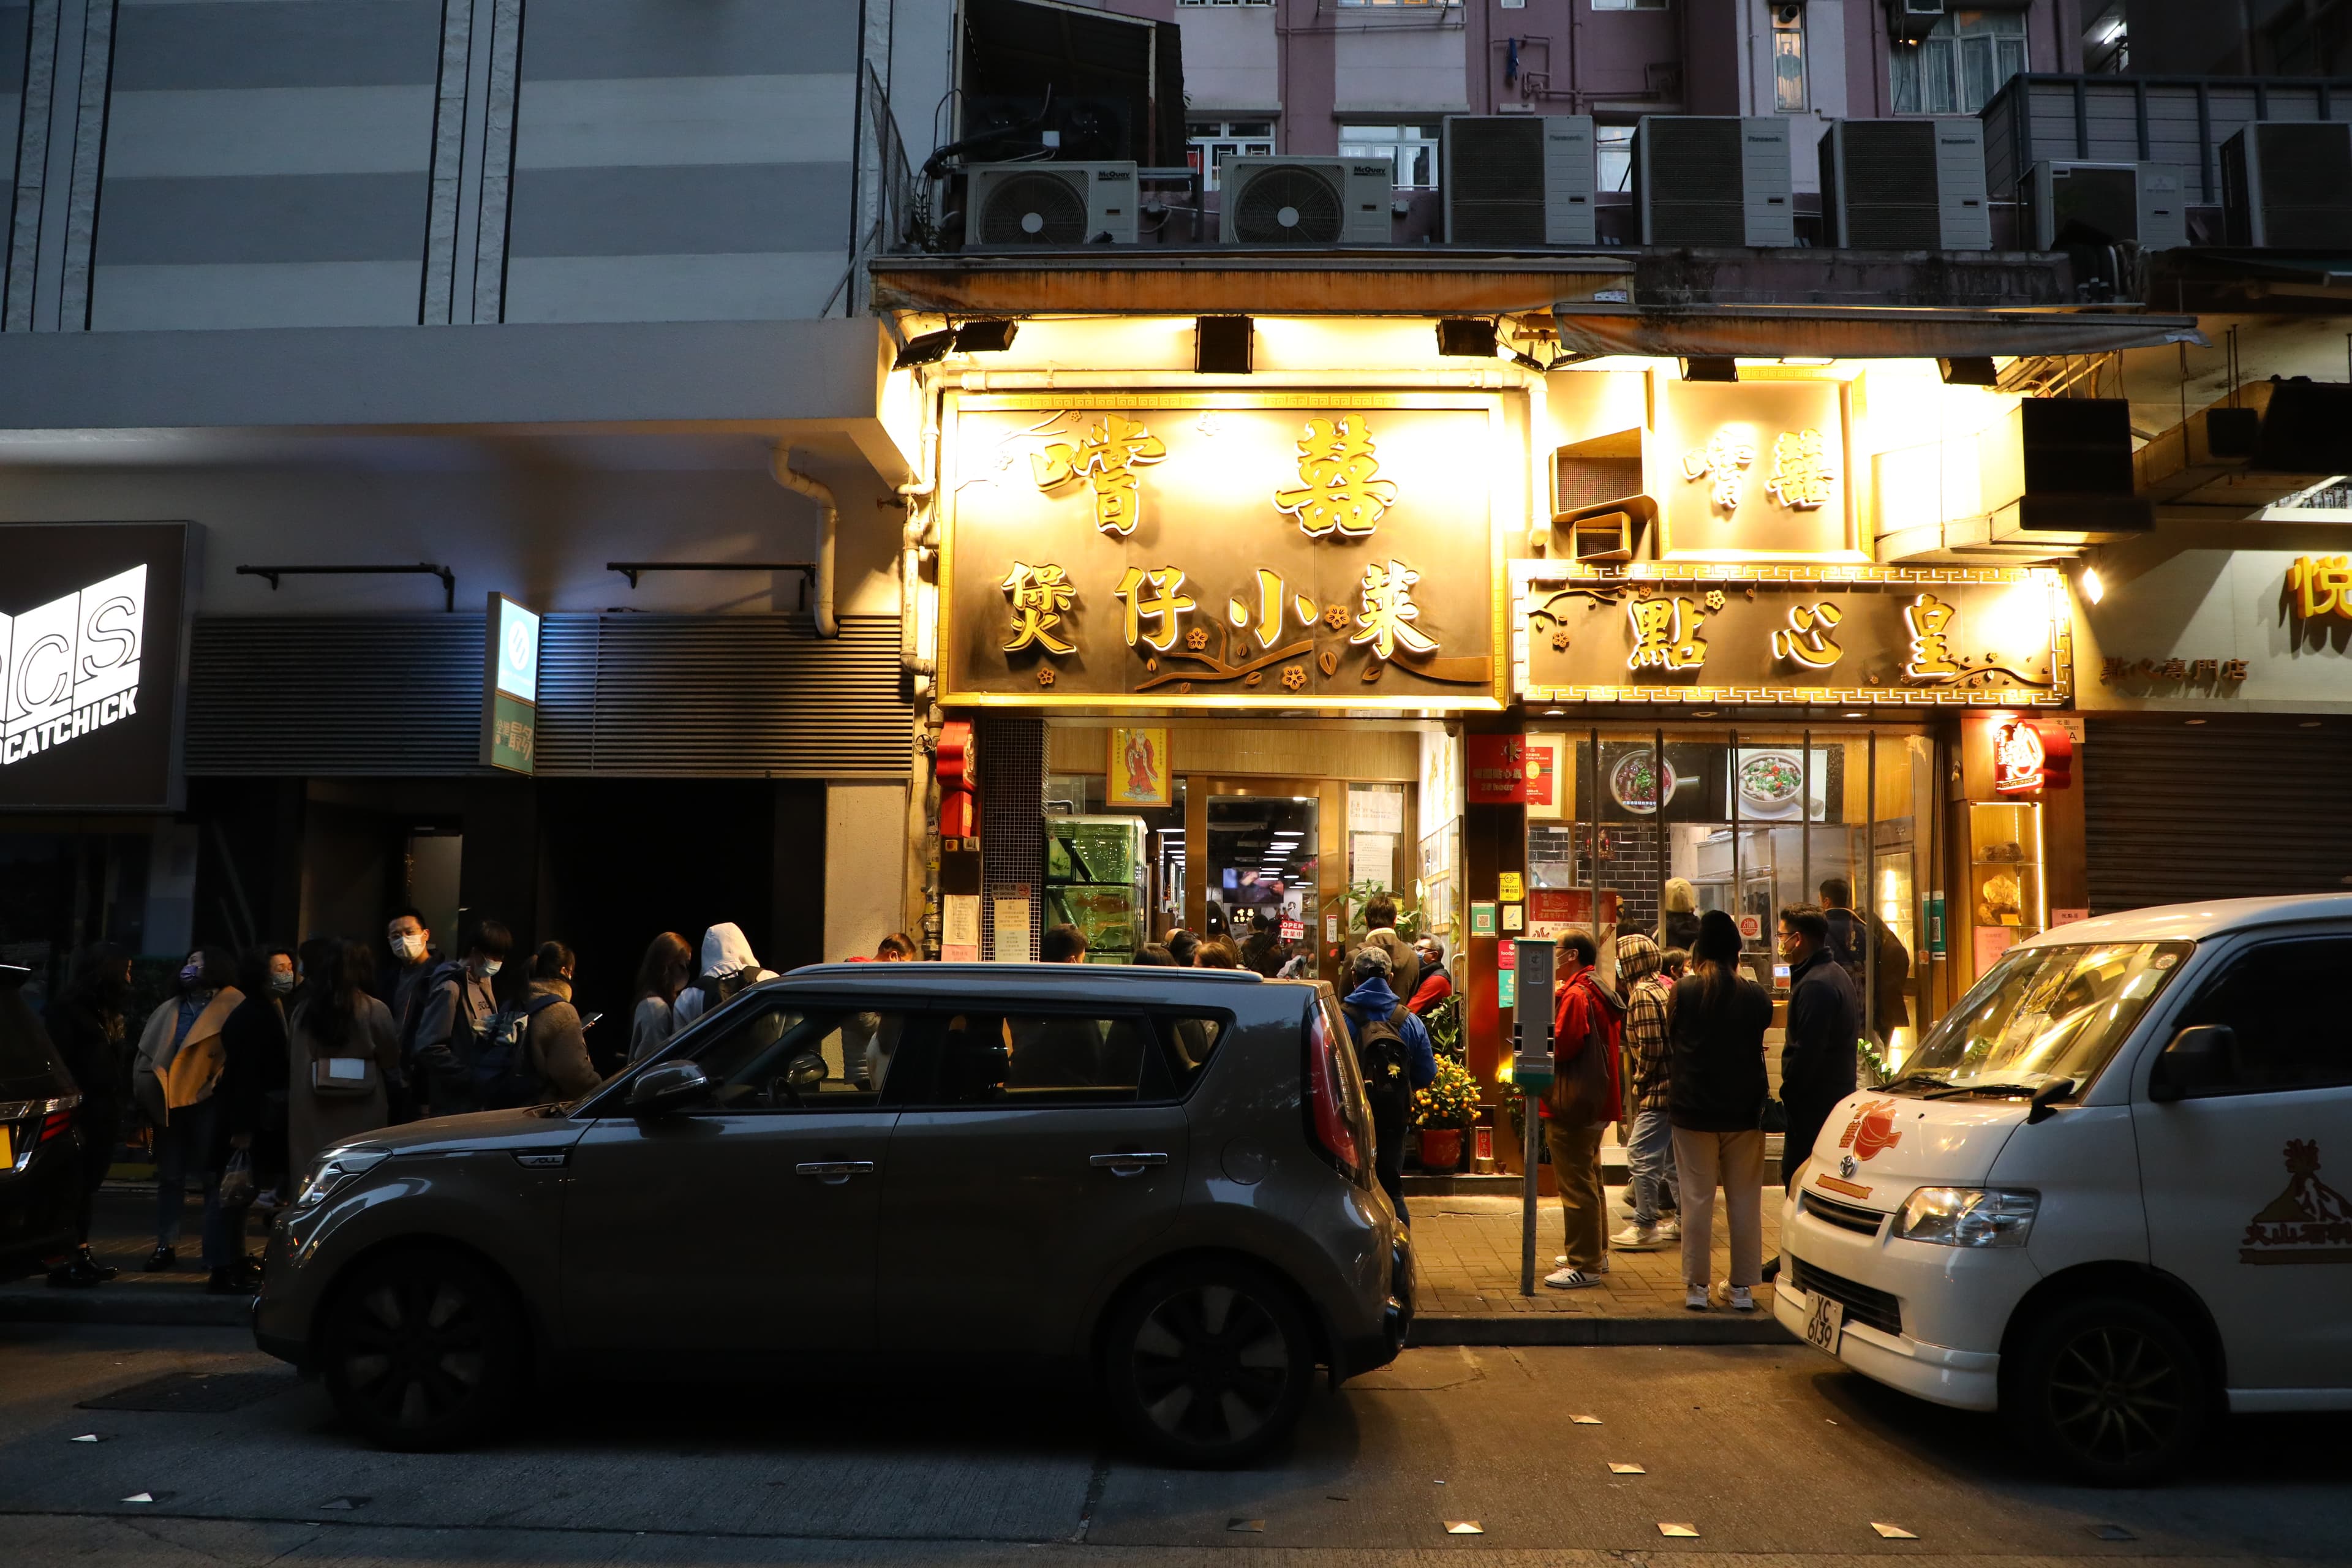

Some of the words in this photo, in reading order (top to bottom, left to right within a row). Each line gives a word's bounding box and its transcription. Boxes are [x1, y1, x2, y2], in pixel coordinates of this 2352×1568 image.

[1098, 170, 1131, 179] McQuay
[1001, 558, 1441, 660] 煲仔小菜
[1626, 593, 1961, 678] 點心皇
[1282, 921, 1304, 930] OPEN
[1815, 1295, 1831, 1323] XC
[1807, 1317, 1833, 1349] 6139
